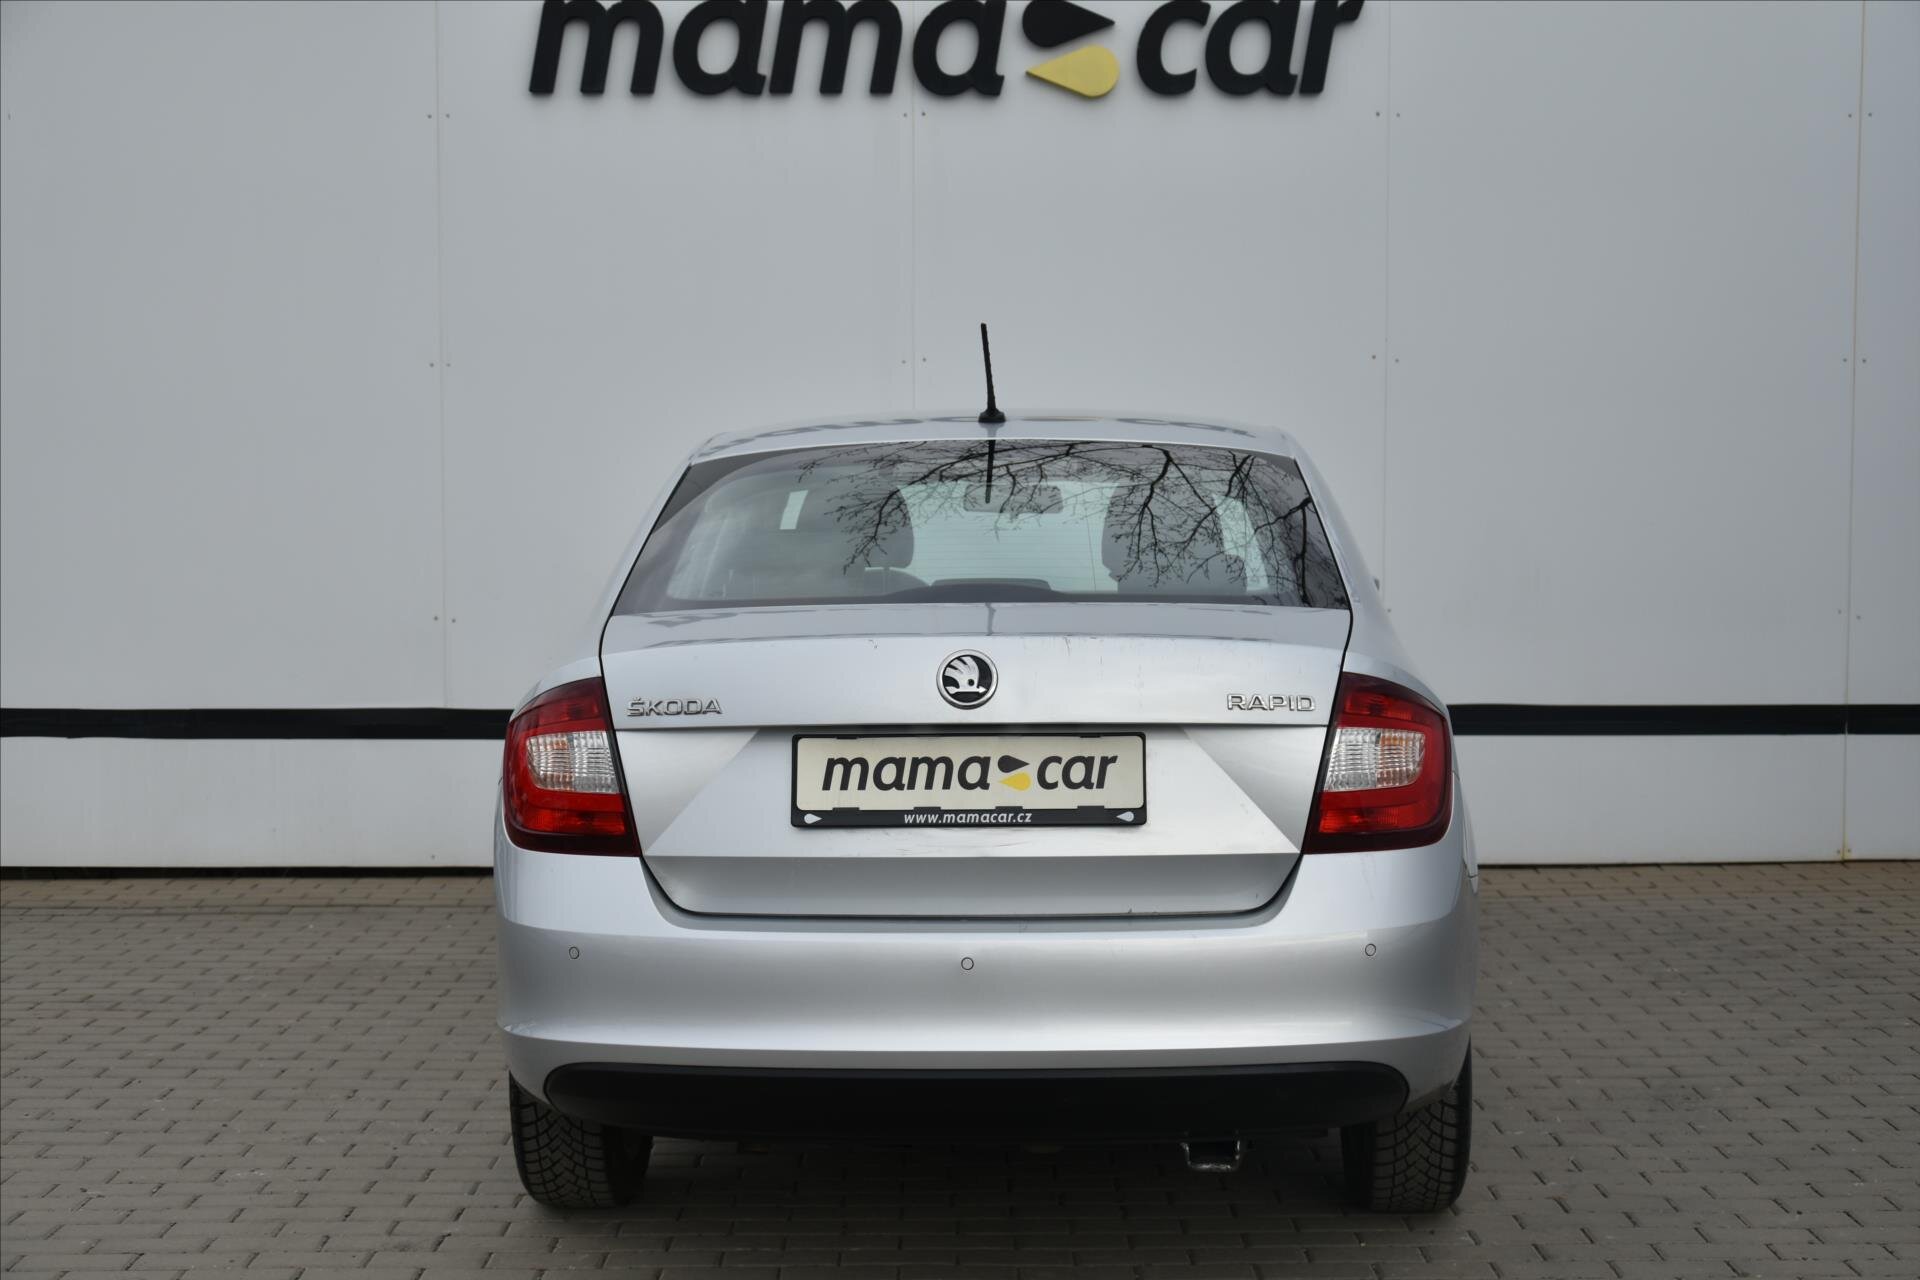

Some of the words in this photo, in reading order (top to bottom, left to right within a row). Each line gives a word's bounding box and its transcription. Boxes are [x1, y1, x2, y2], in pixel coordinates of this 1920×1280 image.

[529, 0, 1005, 96] mama
[1136, 0, 1363, 96] car
[627, 697, 722, 717] ŠKODA
[1226, 693, 1316, 711] RAPID
[821, 755, 992, 791] mama
[1036, 755, 1119, 790] car
[903, 811, 1033, 825] www.mamacar.cz
